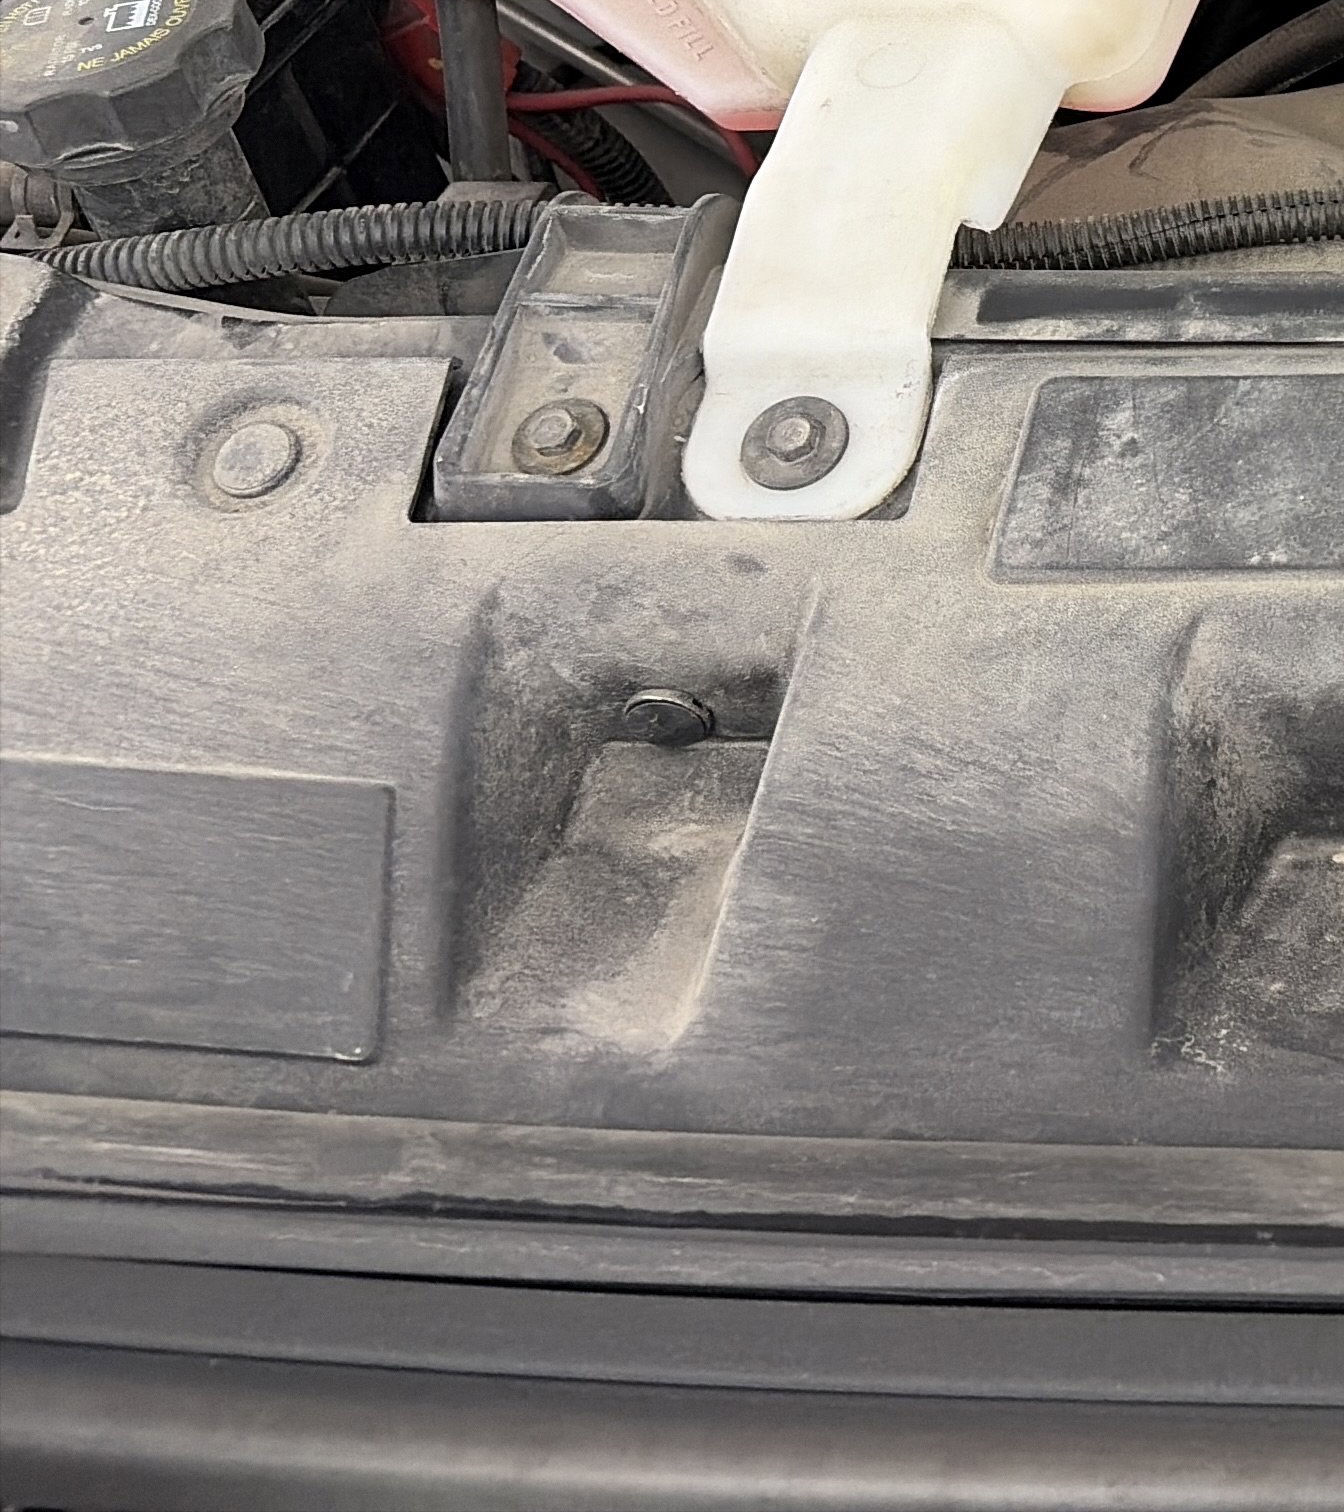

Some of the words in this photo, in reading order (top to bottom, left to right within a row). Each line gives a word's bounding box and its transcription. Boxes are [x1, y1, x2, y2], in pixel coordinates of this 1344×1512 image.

[77, 56, 106, 72] NE
[109, 28, 171, 62] JAMAIS
[667, 15, 714, 62] FILL
